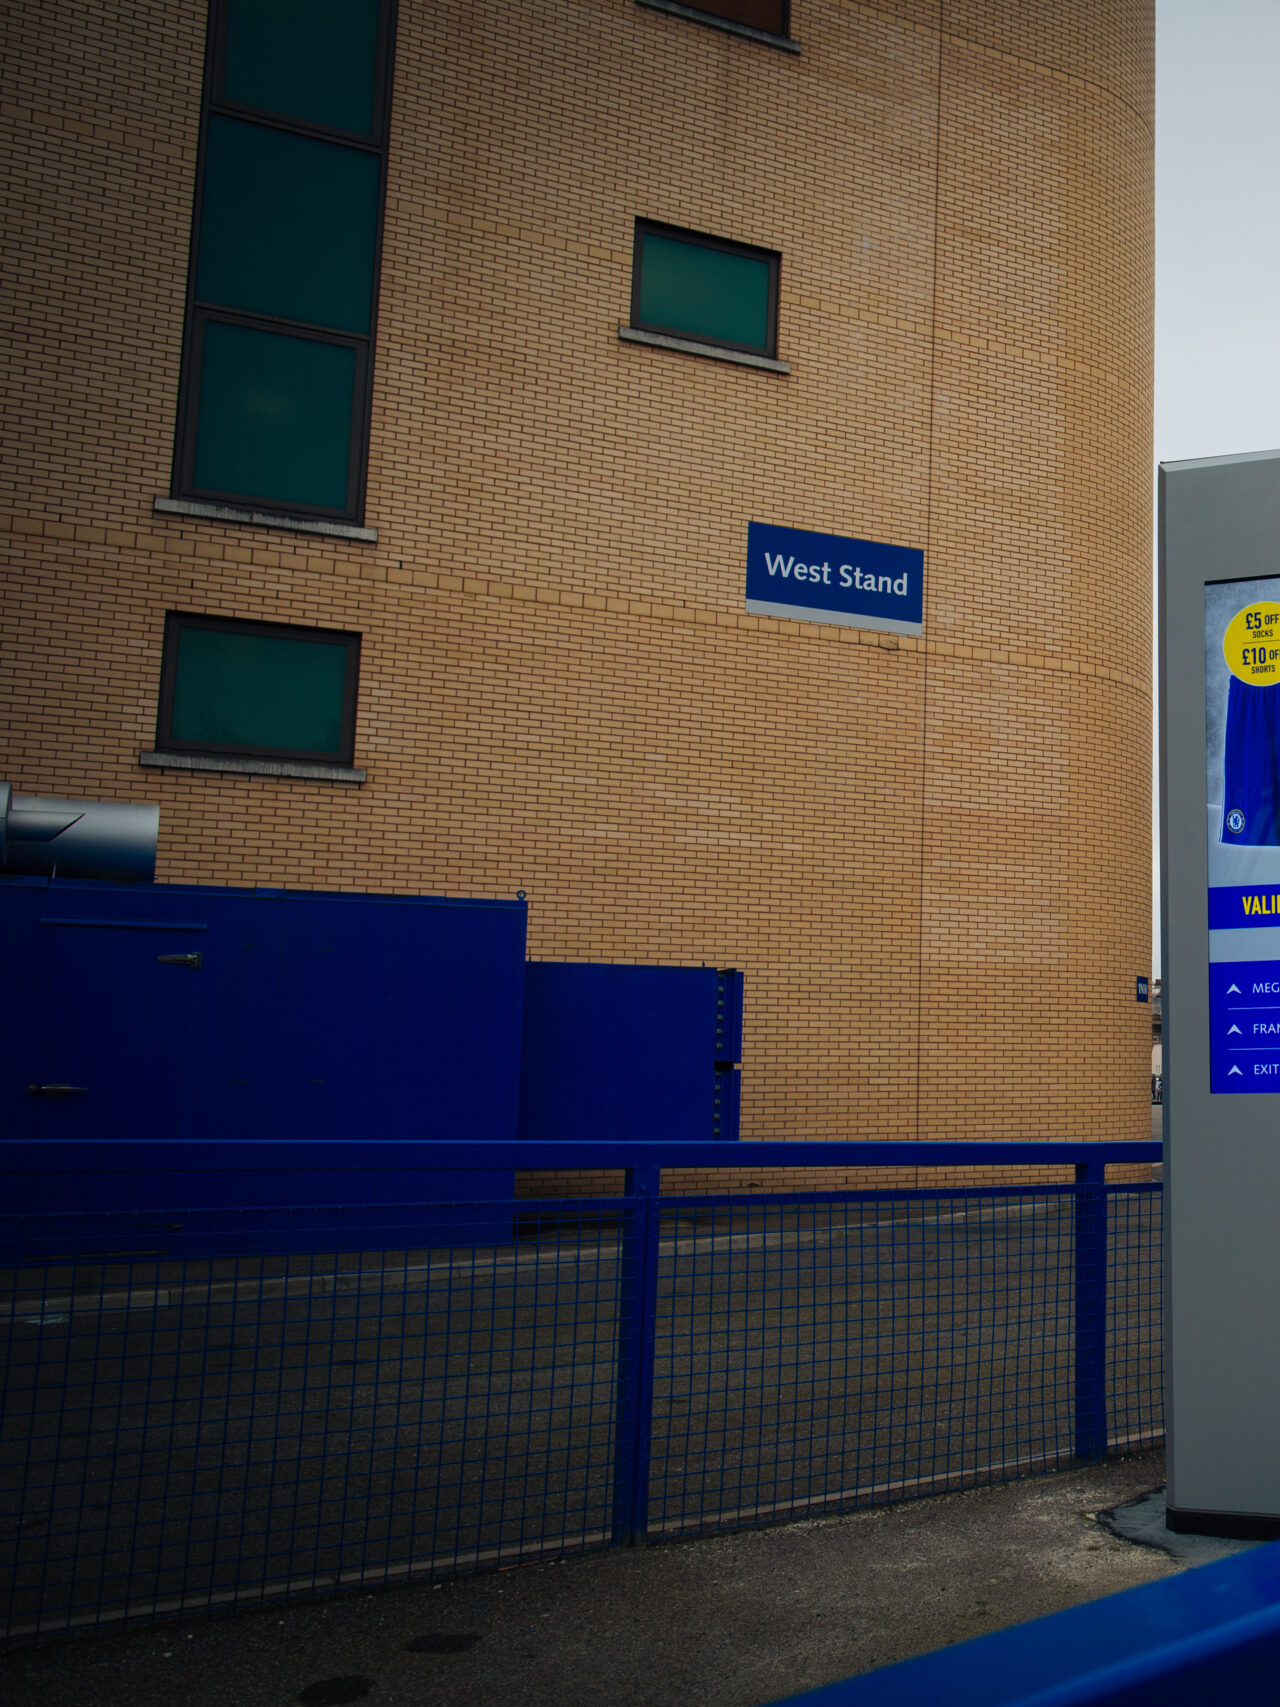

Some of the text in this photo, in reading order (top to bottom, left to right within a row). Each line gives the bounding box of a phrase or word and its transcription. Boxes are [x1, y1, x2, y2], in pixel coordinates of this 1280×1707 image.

[764, 552, 908, 596] West Stand
[1245, 612, 1280, 630] £5 OFF
[1252, 629, 1274, 639] SOCKS
[1242, 647, 1267, 665] £10
[1251, 664, 1276, 674] SHORTS
[1253, 1064, 1280, 1075] EXIT
